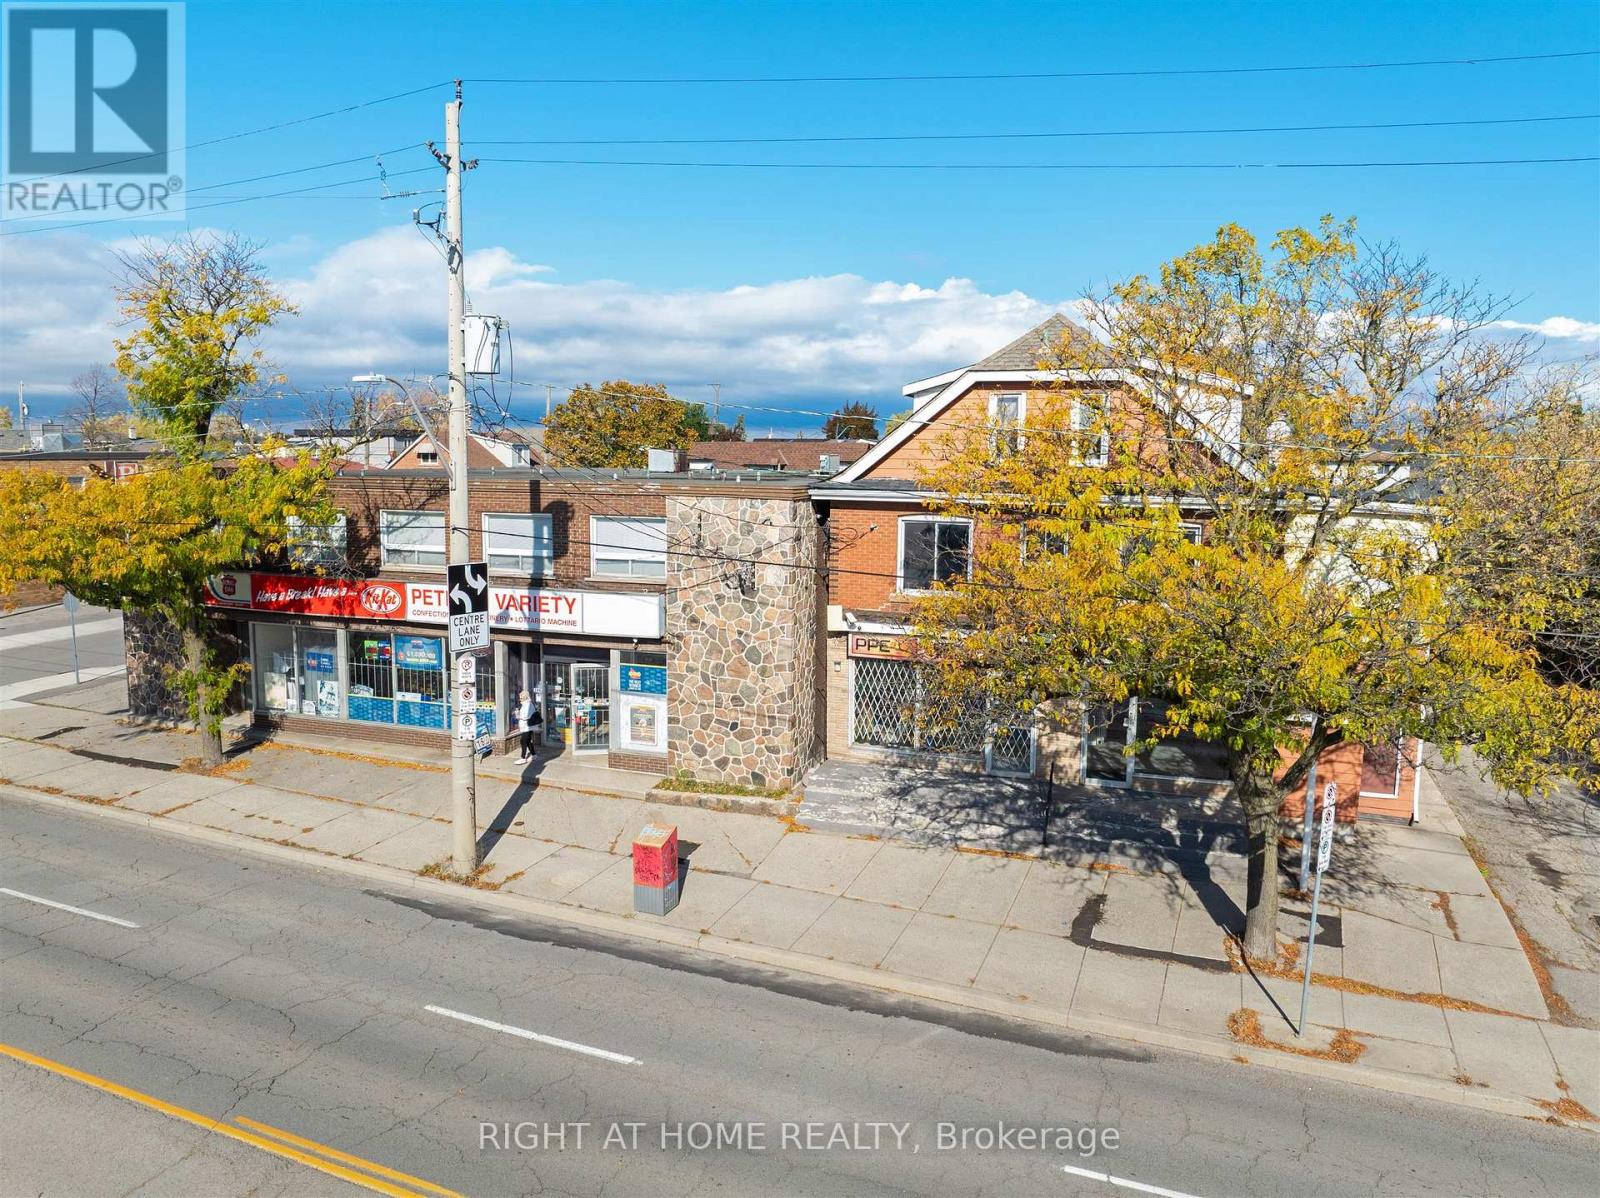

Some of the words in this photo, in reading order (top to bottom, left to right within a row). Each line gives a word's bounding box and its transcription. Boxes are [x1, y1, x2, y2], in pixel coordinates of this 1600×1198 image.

[256, 590, 277, 602] Have
[285, 586, 316, 600] Break!
[317, 586, 339, 598] Have
[412, 588, 449, 607] PET
[495, 593, 577, 615] VARIETY
[453, 614, 485, 627] CENTRE
[515, 616, 546, 625] LOTTARIO
[547, 618, 577, 627] MACHINE
[458, 625, 481, 637] LANE
[459, 635, 480, 648] ONLY
